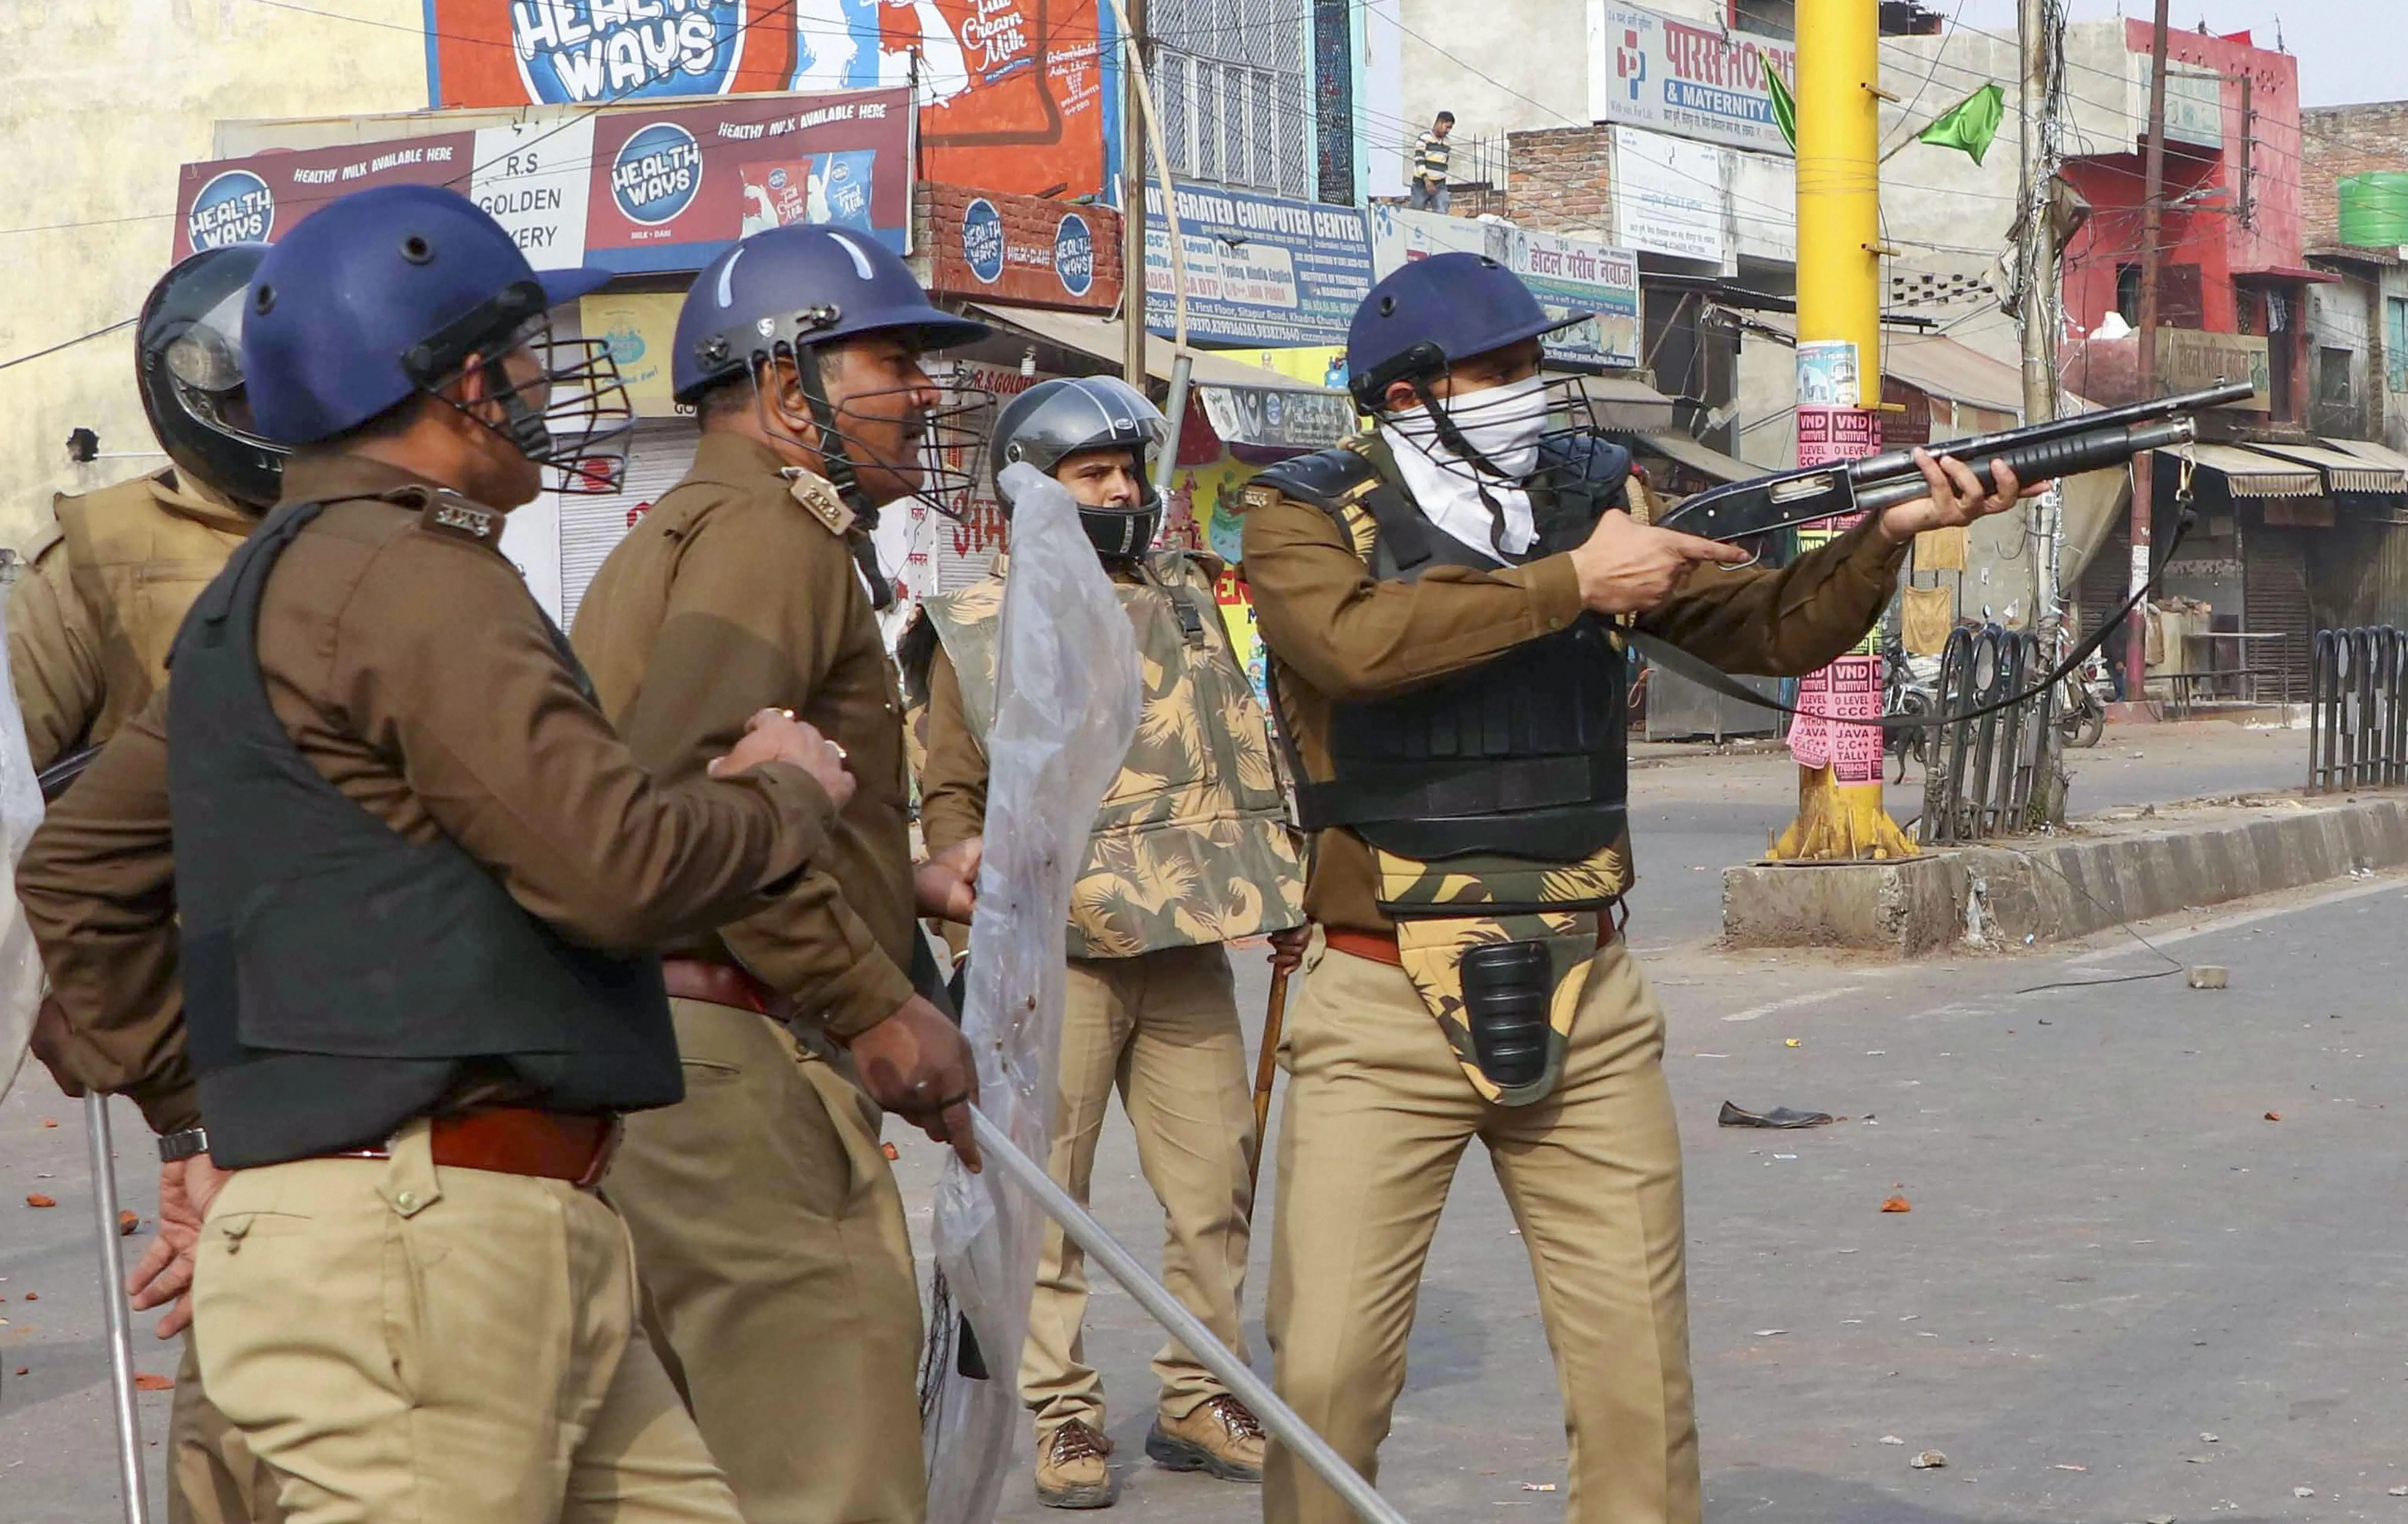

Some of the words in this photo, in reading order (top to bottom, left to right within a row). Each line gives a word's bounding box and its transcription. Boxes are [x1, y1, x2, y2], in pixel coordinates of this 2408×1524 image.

[514, 0, 733, 56] HEAL
[962, 12, 1023, 50] Cream
[554, 12, 715, 101] WAYS
[976, 29, 1027, 71] Milk
[1668, 82, 1678, 102] &
[1683, 85, 1766, 120] MATERNITY
[718, 122, 764, 139] HEALTHY
[801, 105, 854, 129] AVAILABLE
[859, 104, 886, 119] HERE
[293, 169, 337, 184] HEALTHY
[342, 162, 367, 181] MILK
[372, 148, 422, 173] AVAILABLE
[427, 146, 453, 162] HERE
[507, 153, 538, 177] R.S
[612, 142, 699, 192] HEALTH
[627, 169, 690, 206] WAYS
[189, 189, 271, 236] HEALTH
[480, 188, 561, 216] GOLDEN
[204, 215, 263, 246] WAYS
[1236, 200, 1312, 235] COMPUTER
[1313, 212, 1365, 242] CENTER
[964, 220, 1001, 248] HEALTH
[1555, 239, 1569, 251] 786
[970, 240, 998, 264] WAYS
[1056, 234, 1092, 261] HEALTH
[1062, 256, 1088, 276] WAYS
[1530, 241, 1562, 275] होटल
[1566, 249, 1596, 281] गरीब
[1146, 296, 1168, 310] Shop
[1195, 301, 1213, 313] First
[1214, 304, 1238, 318] Floor,
[1800, 415, 1826, 429] VND
[1836, 415, 1868, 429] VND
[1835, 431, 1868, 442] INSTITUTE
[1804, 445, 1826, 454] LEVEL
[1834, 446, 1841, 454] O
[1836, 665, 1868, 679] VND
[1836, 680, 1868, 691] INSTITUTE
[1801, 706, 1826, 715] CCC
[1806, 695, 1827, 704] LEVEL
[1835, 696, 1841, 705] O
[1844, 696, 1868, 705] LEVEL
[1837, 706, 1868, 716] CCC
[1797, 728, 1828, 737] JAVA
[1836, 729, 1869, 738] JAVA
[1837, 751, 1868, 760] TALLY
